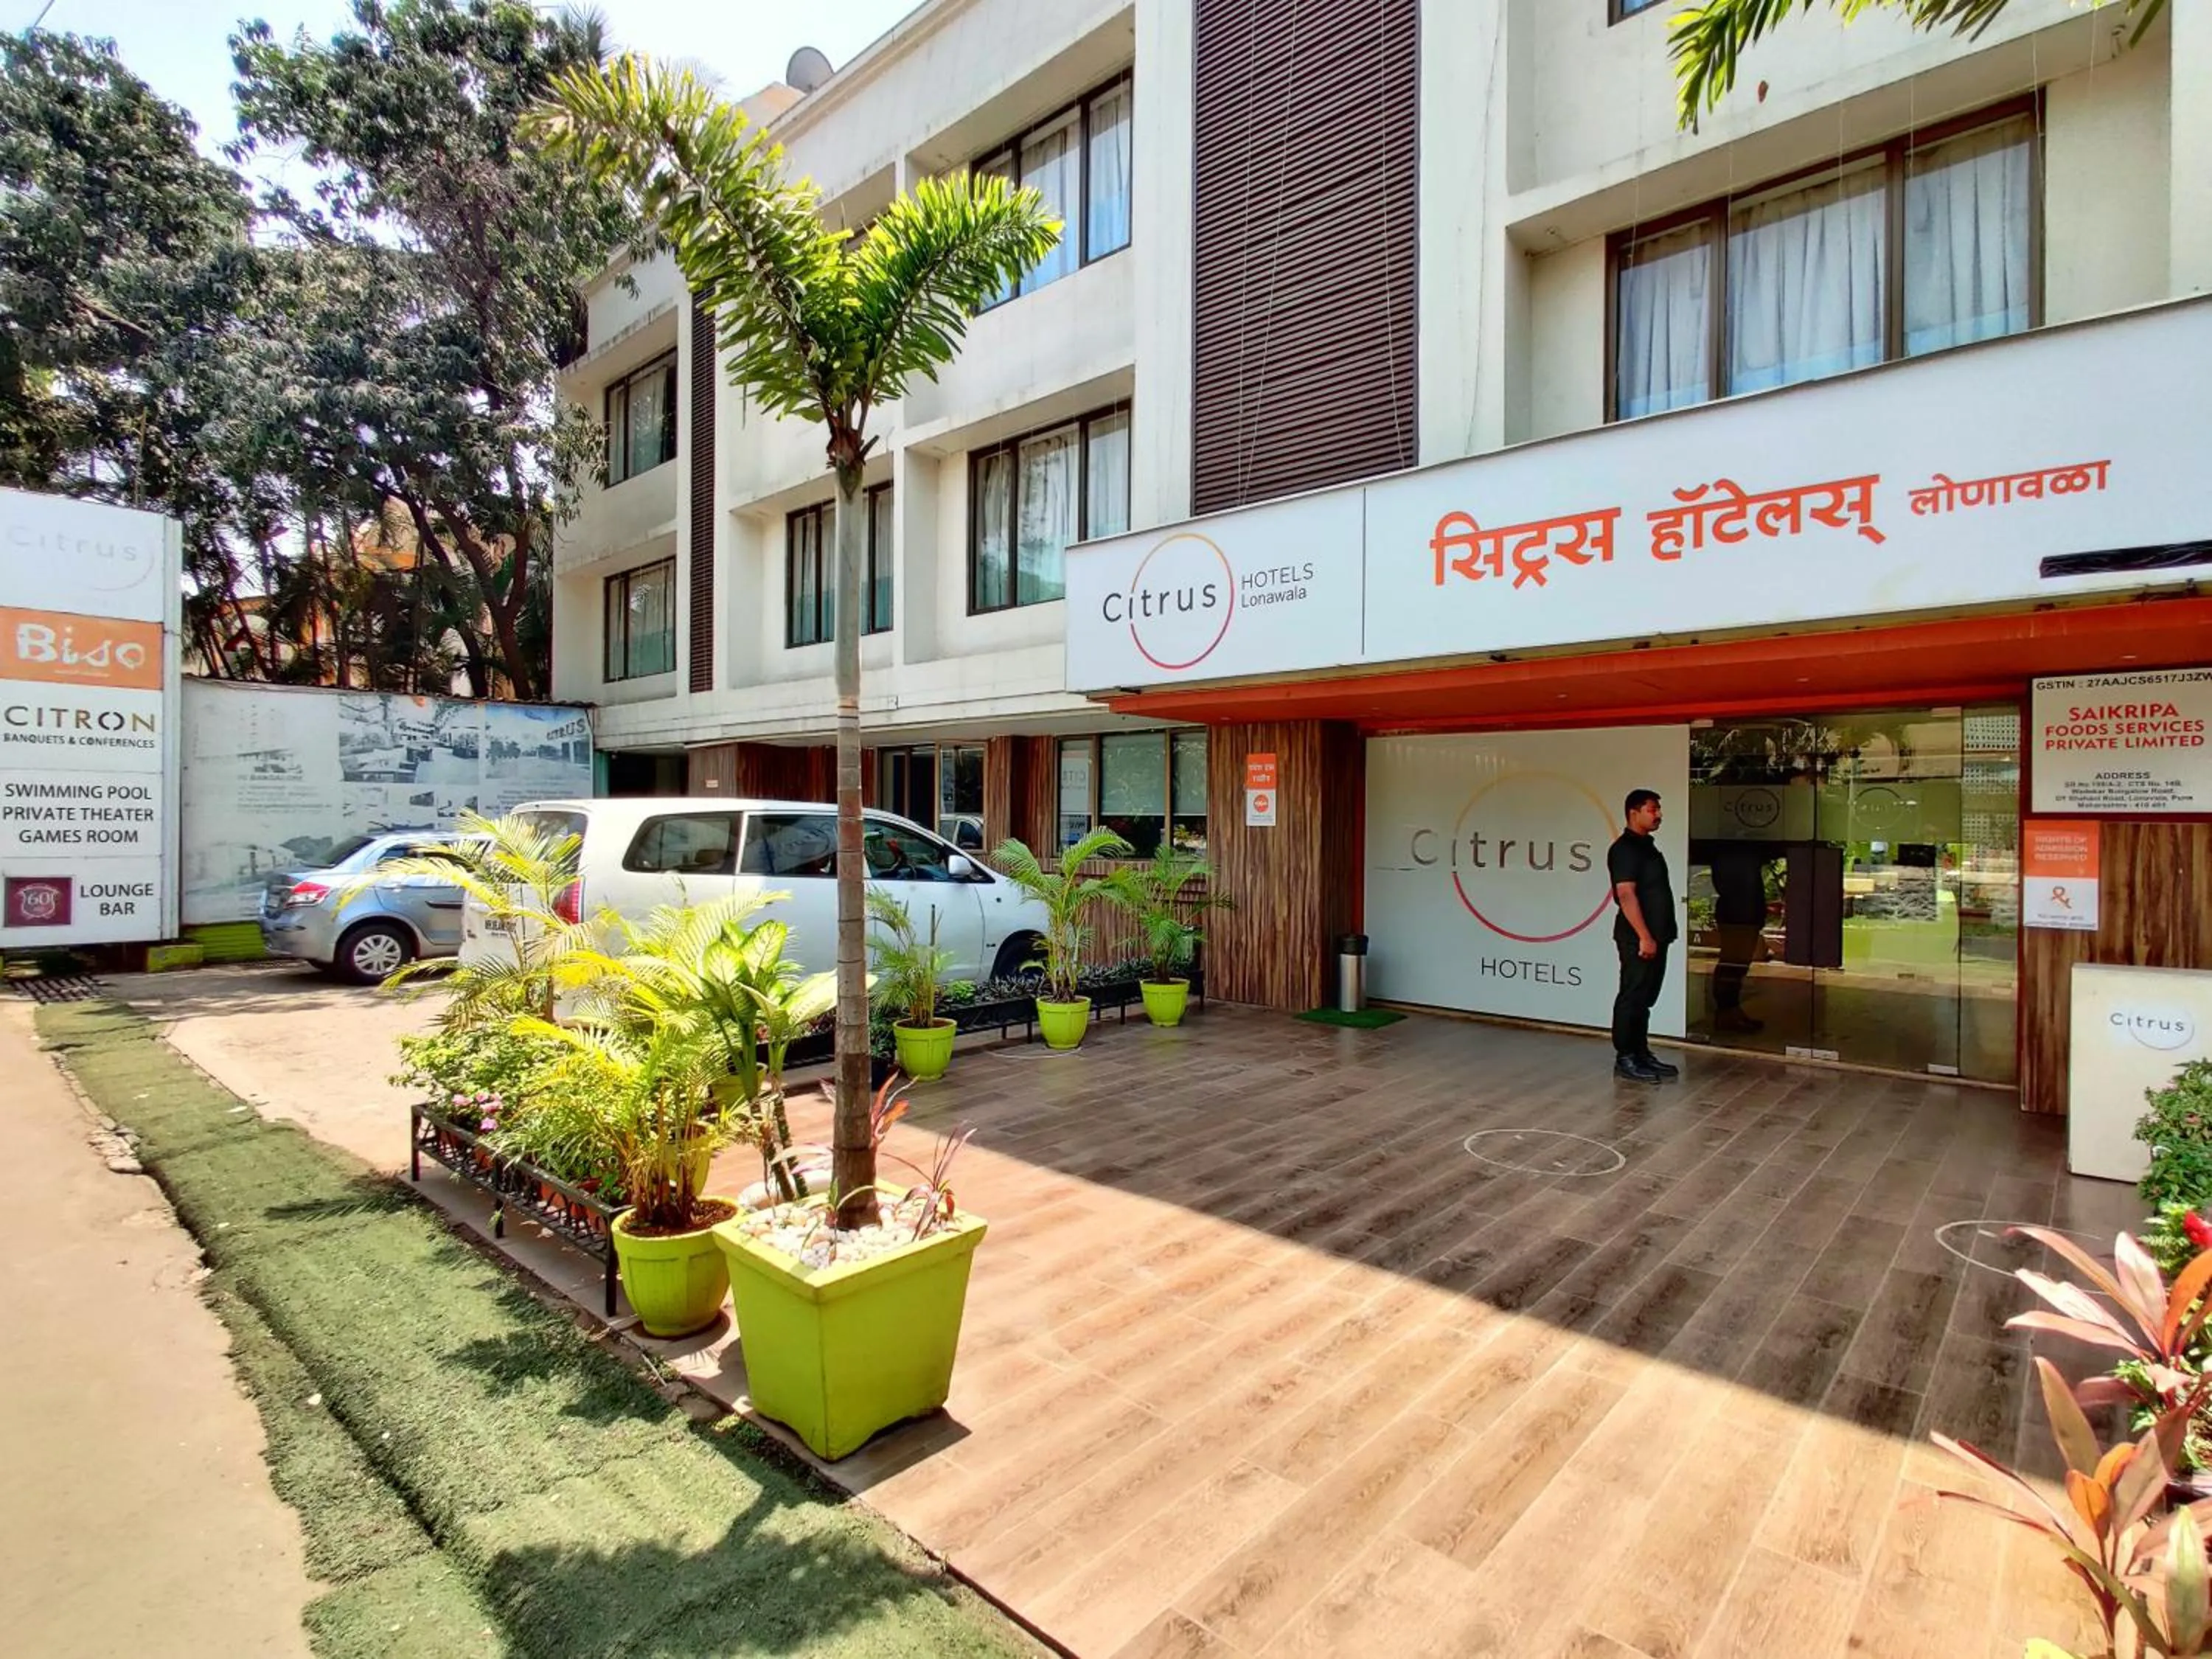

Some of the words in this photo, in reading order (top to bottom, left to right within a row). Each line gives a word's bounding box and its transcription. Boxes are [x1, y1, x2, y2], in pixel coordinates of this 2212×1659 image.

[1430, 507, 1621, 590] सिट्रस
[1647, 473, 1887, 560] हॉटेलस्
[1909, 459, 2111, 516] लोणावळा
[1242, 563, 1314, 590] HOTELS
[1103, 583, 1217, 622] Citrus
[1242, 586, 1307, 608] Lonawala
[2037, 680, 2075, 690] GSTIN
[4, 706, 156, 732] CITRON
[2069, 702, 2180, 721] SAIKRIPA
[2045, 723, 2109, 737] FOODS
[2115, 720, 2205, 735] SERVICES
[3, 733, 65, 744] BANQUETS
[68, 736, 76, 745] &
[79, 737, 155, 748] CONFERENCES
[2045, 738, 2118, 751] PRIVATE
[2125, 735, 2204, 748] LIMITED
[5, 783, 102, 799] SWIMMING
[107, 786, 152, 799] POOL
[2, 807, 75, 821] PRIVATE
[80, 807, 153, 821] THEATER
[19, 830, 81, 843] GAMES
[86, 830, 138, 843] ROOM
[1411, 828, 1593, 872] Citrus
[80, 883, 153, 897] LOUNGE
[100, 902, 135, 916] BAR
[1481, 957, 1582, 986] HOTELS
[2110, 1012, 2185, 1032] Citrus
